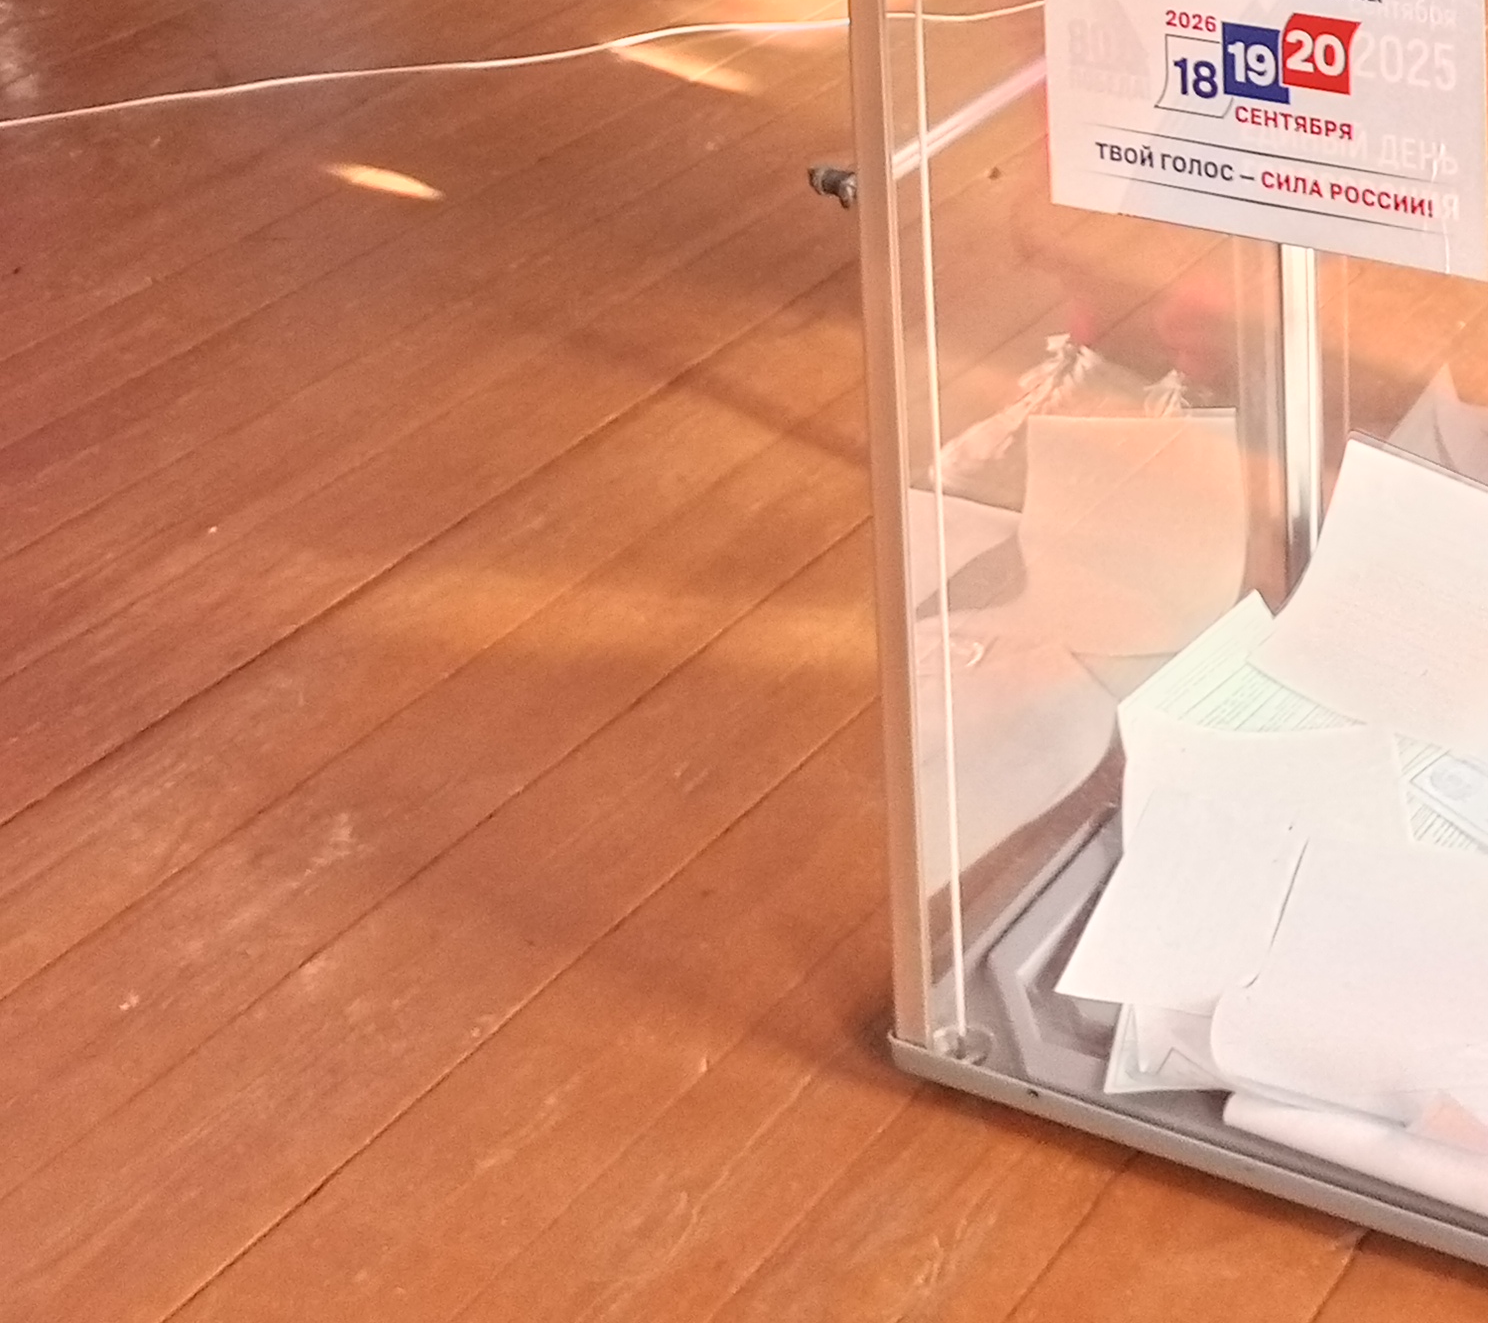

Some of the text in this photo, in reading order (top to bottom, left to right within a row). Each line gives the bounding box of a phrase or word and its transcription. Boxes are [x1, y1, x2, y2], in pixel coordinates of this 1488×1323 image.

[1165, 10, 1217, 34] 2026
[1173, 57, 1219, 99] 18
[1227, 41, 1275, 87] 19
[1285, 30, 1346, 77] 20
[1235, 107, 1353, 141] СЕНТЯБРЯ
[1095, 141, 1154, 169] ТВОЙ
[1161, 153, 1234, 182] ГОЛОС
[1261, 171, 1324, 199] СИЛА
[1330, 183, 1435, 218] РОССИИ!
